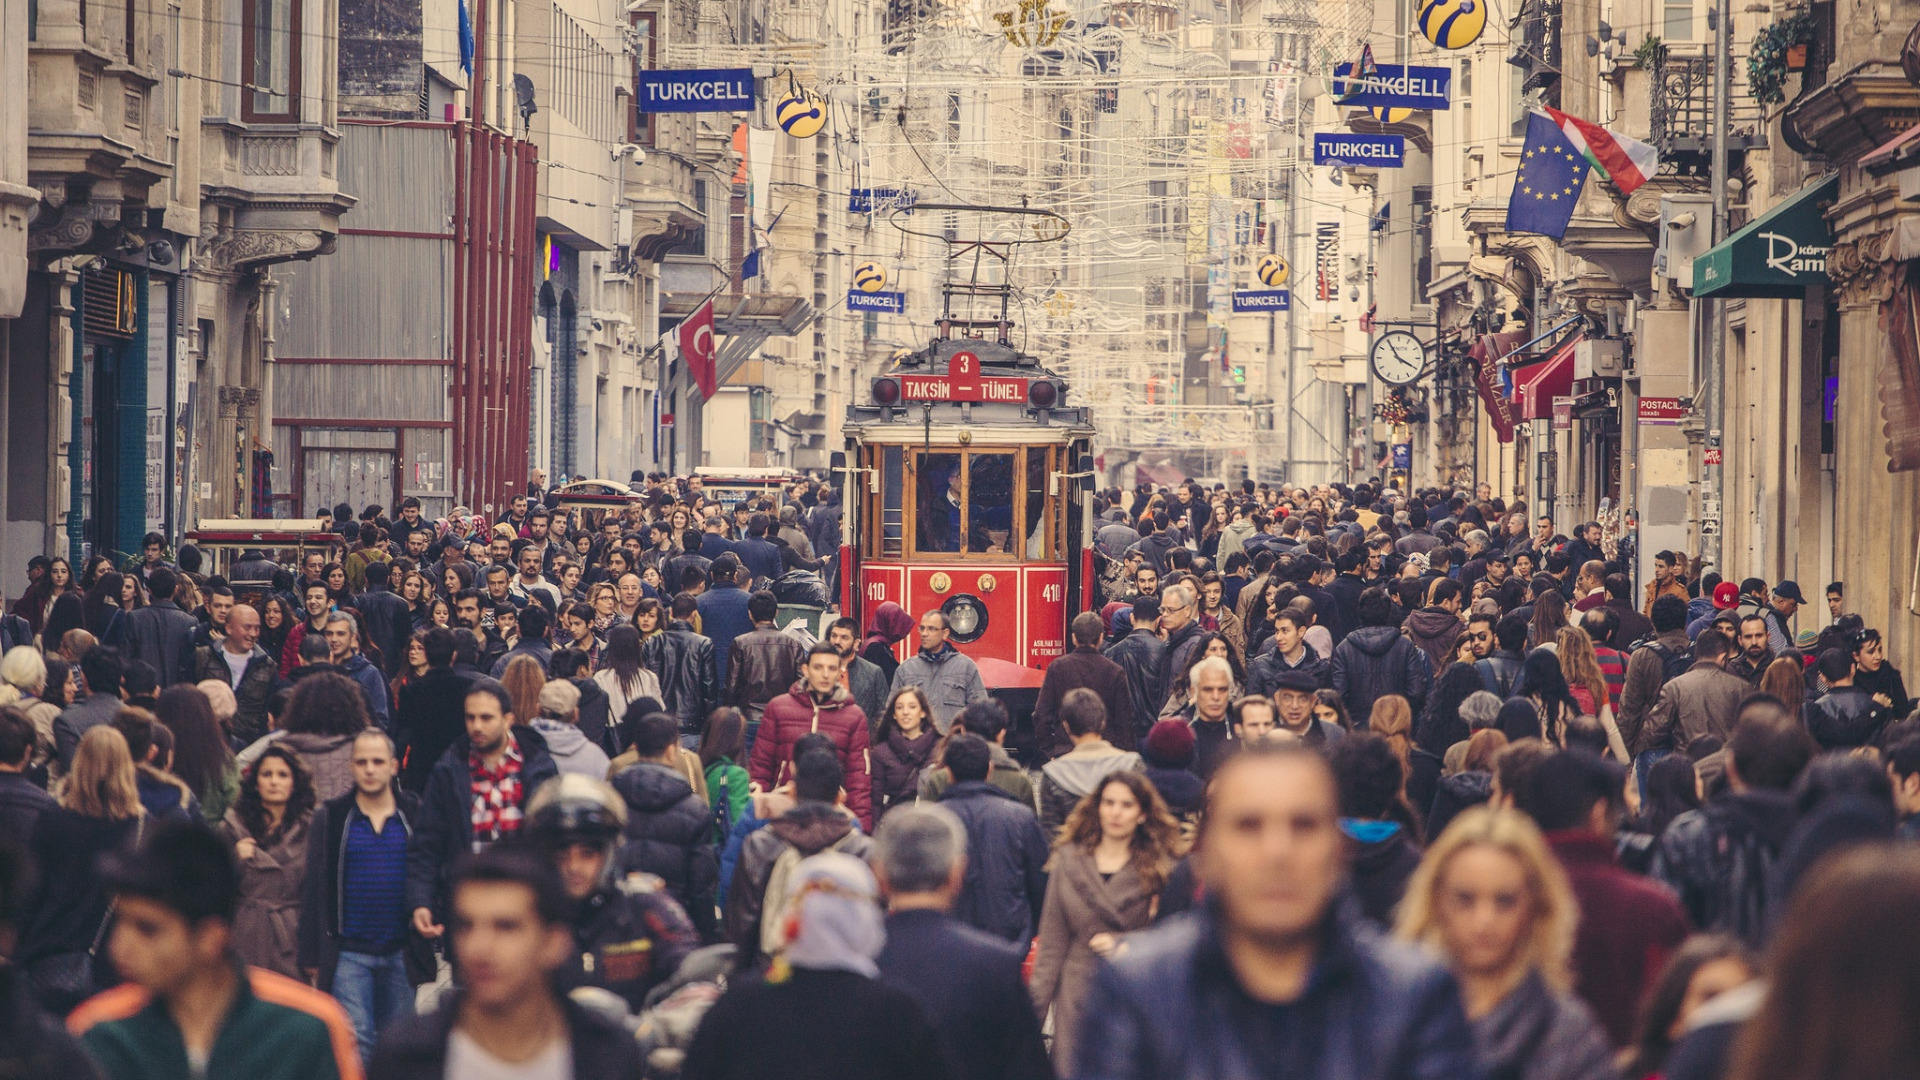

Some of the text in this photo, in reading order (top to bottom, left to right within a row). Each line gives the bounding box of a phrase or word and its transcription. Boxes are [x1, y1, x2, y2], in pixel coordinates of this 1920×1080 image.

[646, 82, 749, 100] TURKCELL
[1319, 142, 1400, 158] TURKCELL
[1758, 231, 1829, 277] Ram
[1799, 244, 1831, 255] KÖFT
[850, 295, 901, 307] TURKCELL
[1236, 296, 1287, 306] TURKCELL
[960, 355, 969, 373] 3
[981, 381, 1022, 399] TÜNEL
[1641, 401, 1683, 409] POSTACIL
[867, 582, 885, 601] 410
[1042, 584, 1061, 602] 410
